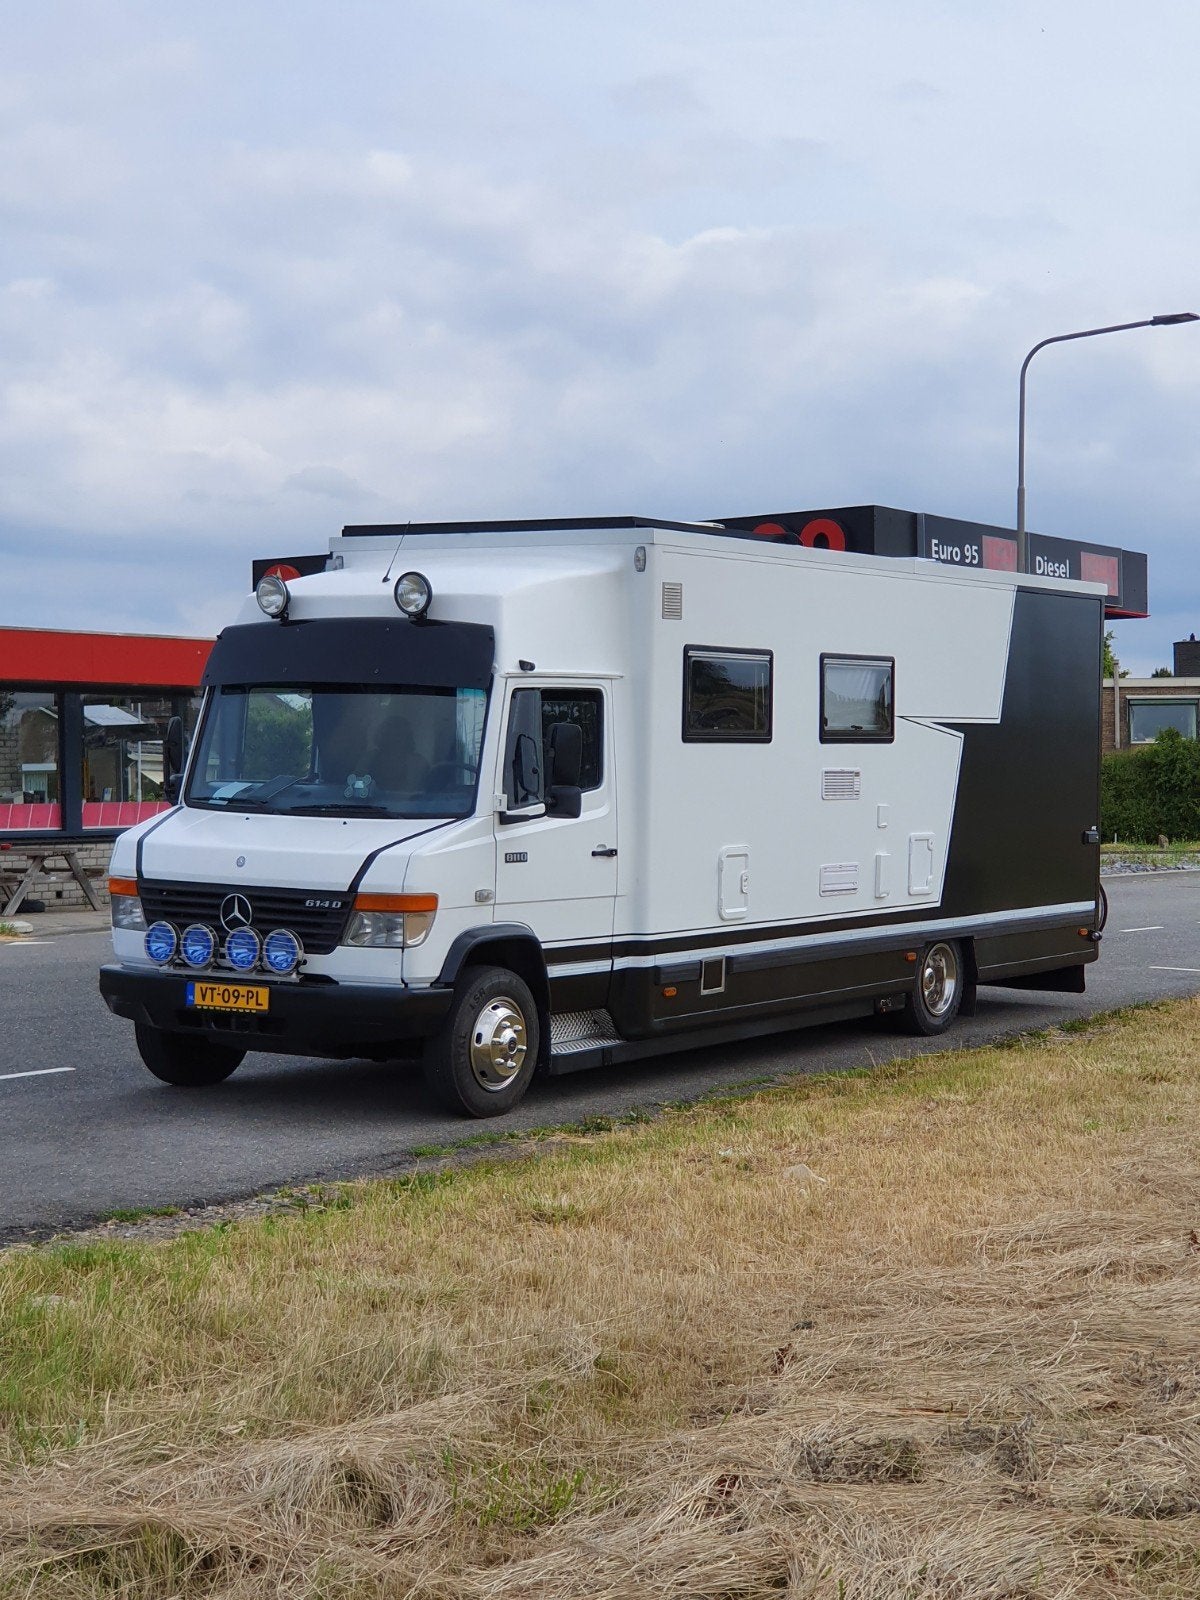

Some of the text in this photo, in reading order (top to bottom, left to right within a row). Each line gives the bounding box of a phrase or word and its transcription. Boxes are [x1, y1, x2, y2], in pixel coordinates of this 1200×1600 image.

[931, 539, 979, 565] Euro 95
[1035, 555, 1070, 579] Diesel
[200, 986, 263, 1007] VT-09-PL
